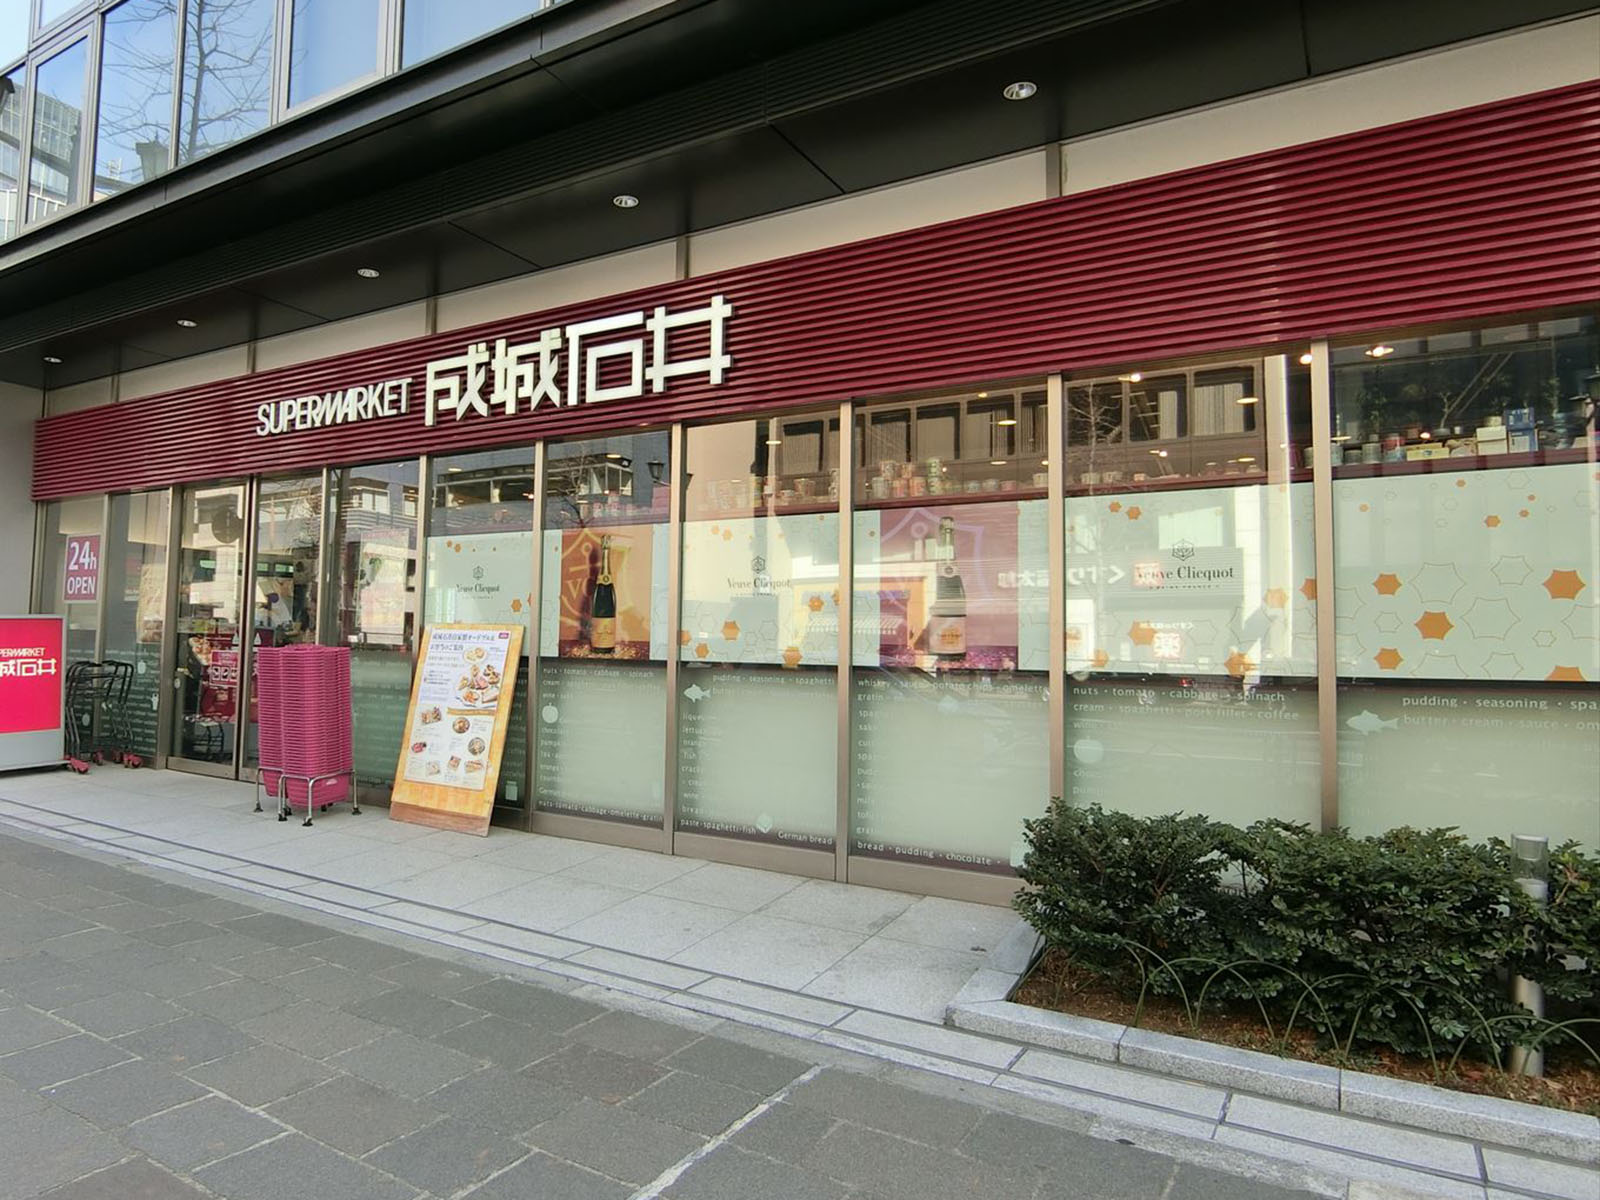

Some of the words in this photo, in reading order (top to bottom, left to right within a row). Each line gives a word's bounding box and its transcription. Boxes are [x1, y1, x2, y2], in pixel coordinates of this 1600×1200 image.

[424, 294, 733, 427] 成城石井
[256, 377, 413, 437] SUPERMARKET
[68, 540, 97, 571] 24h
[1177, 566, 1233, 581] Clicquot
[66, 575, 96, 595] OPEN
[1073, 687, 1099, 696] nuts
[1112, 688, 1156, 698] tomato
[1169, 689, 1219, 701] cabbage
[1237, 691, 1285, 703] spinach
[1402, 695, 1458, 708] pudding
[1475, 698, 1548, 710] seasoning
[1073, 702, 1105, 712] cream
[1462, 716, 1504, 727] cream
[778, 830, 809, 843] German
[809, 834, 834, 846] bread
[857, 841, 885, 851] bread
[895, 846, 935, 859] pudding
[946, 853, 993, 866] chocolate
